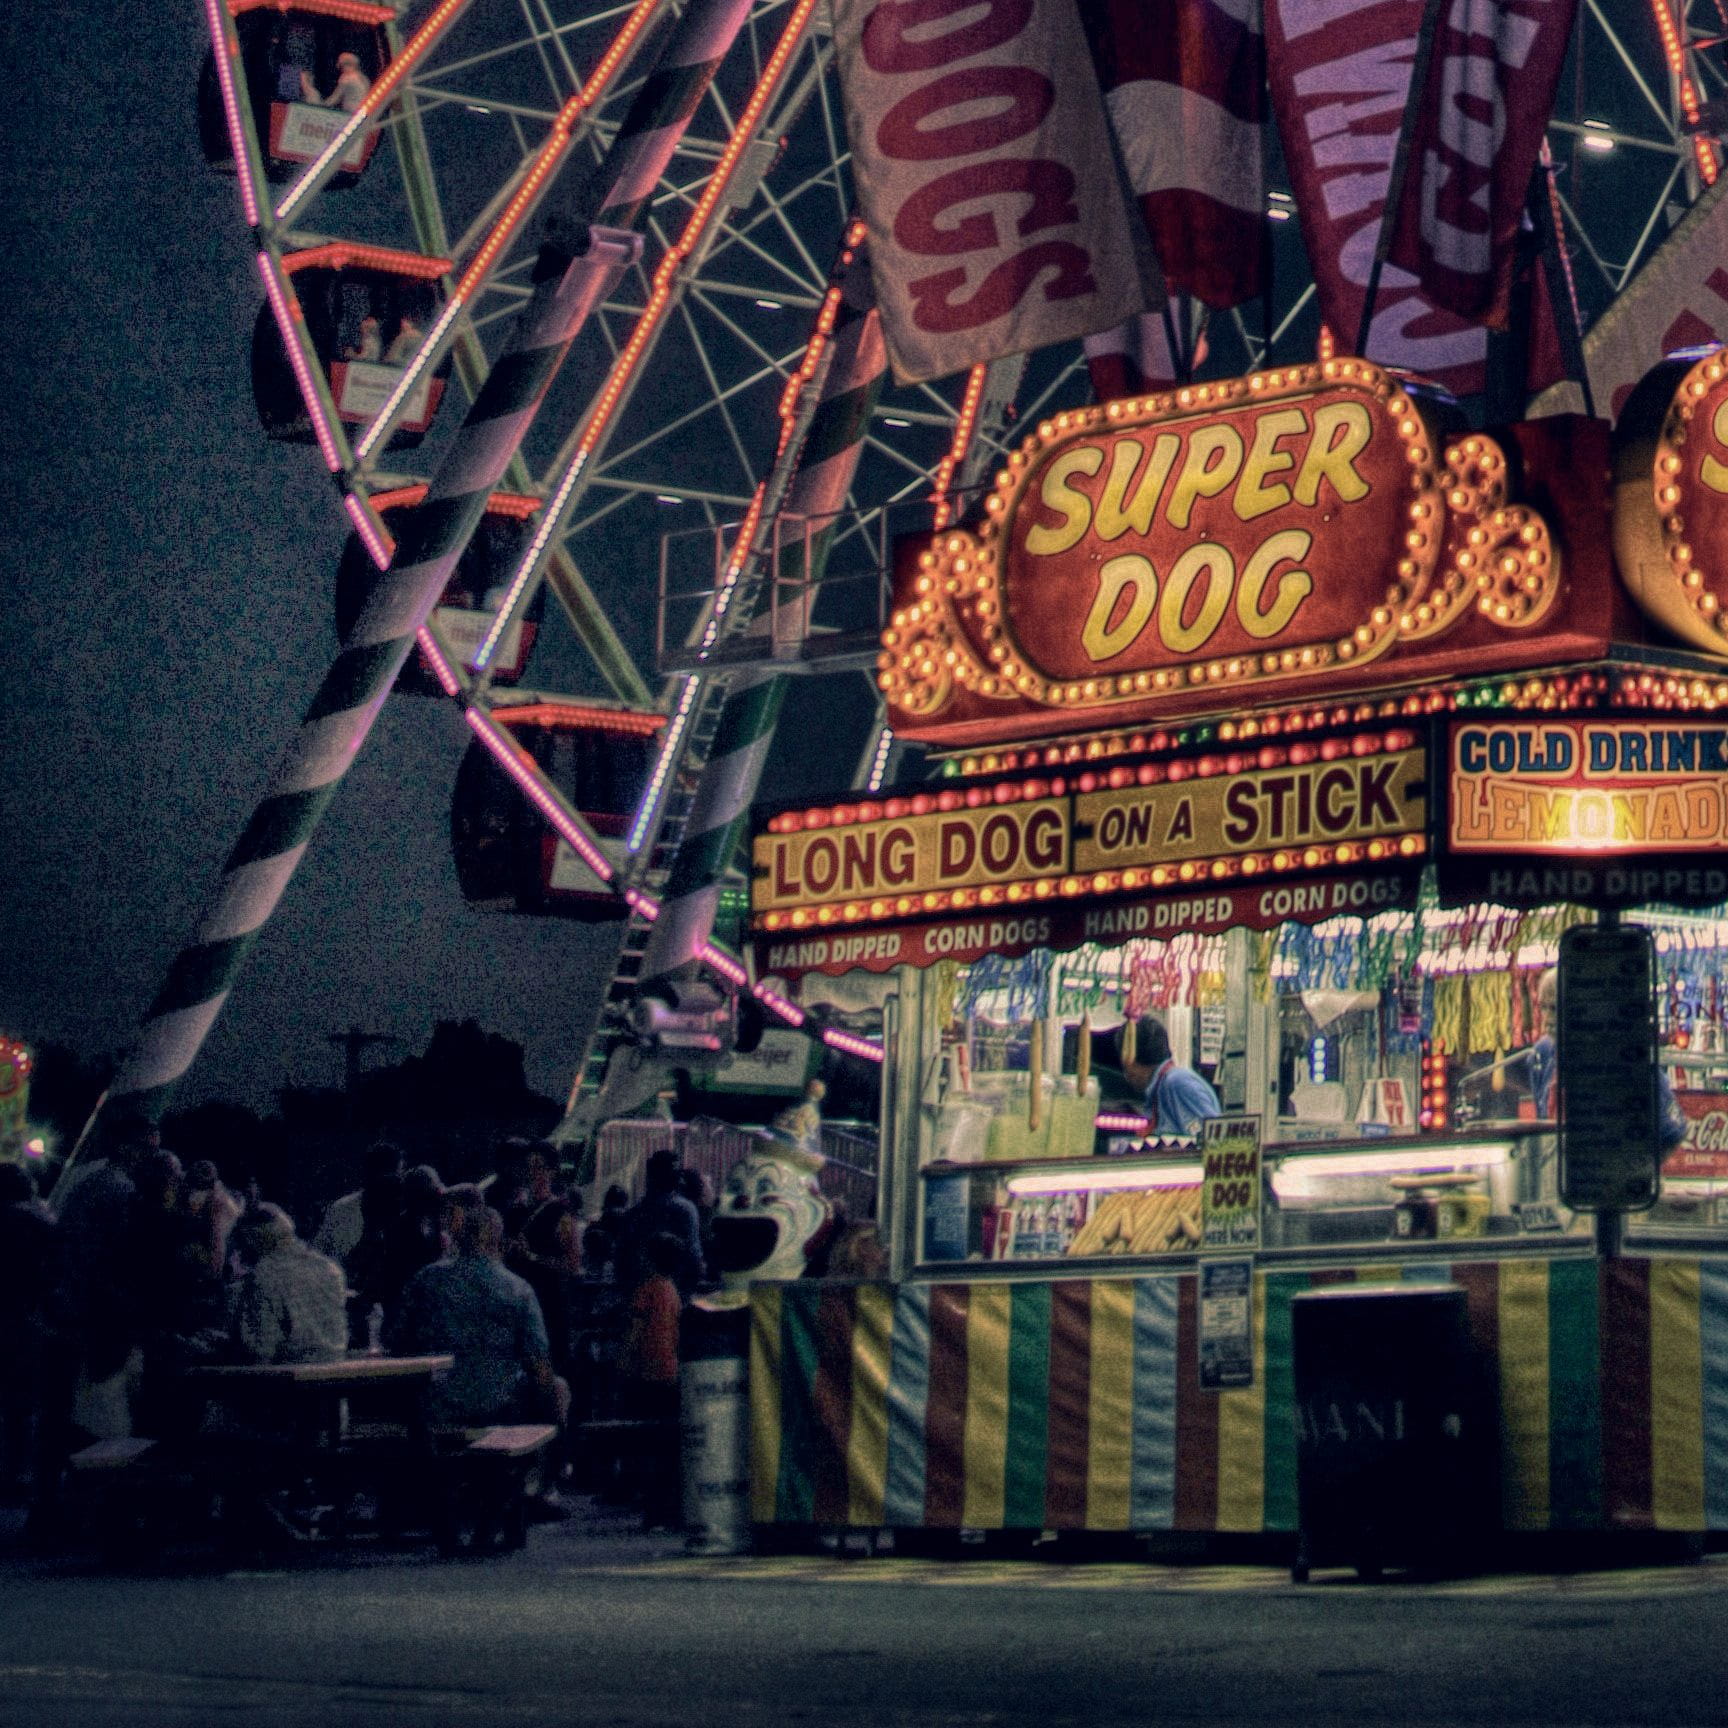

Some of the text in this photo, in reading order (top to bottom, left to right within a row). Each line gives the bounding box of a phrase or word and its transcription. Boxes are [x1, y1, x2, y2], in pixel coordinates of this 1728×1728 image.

[1026, 400, 1372, 556] SUPER
[1081, 529, 1313, 662] DOG
[1460, 731, 1572, 772] COLD
[775, 761, 1404, 897] LONG DOG ON A STICK
[1489, 868, 1728, 897] HAND DIPPED
[768, 876, 1402, 968] HAND DIPPED CORN DOGS HAND DIPPED CORN DOGS
[1206, 1150, 1258, 1177] MEGA
[1212, 1182, 1251, 1206] DOG
